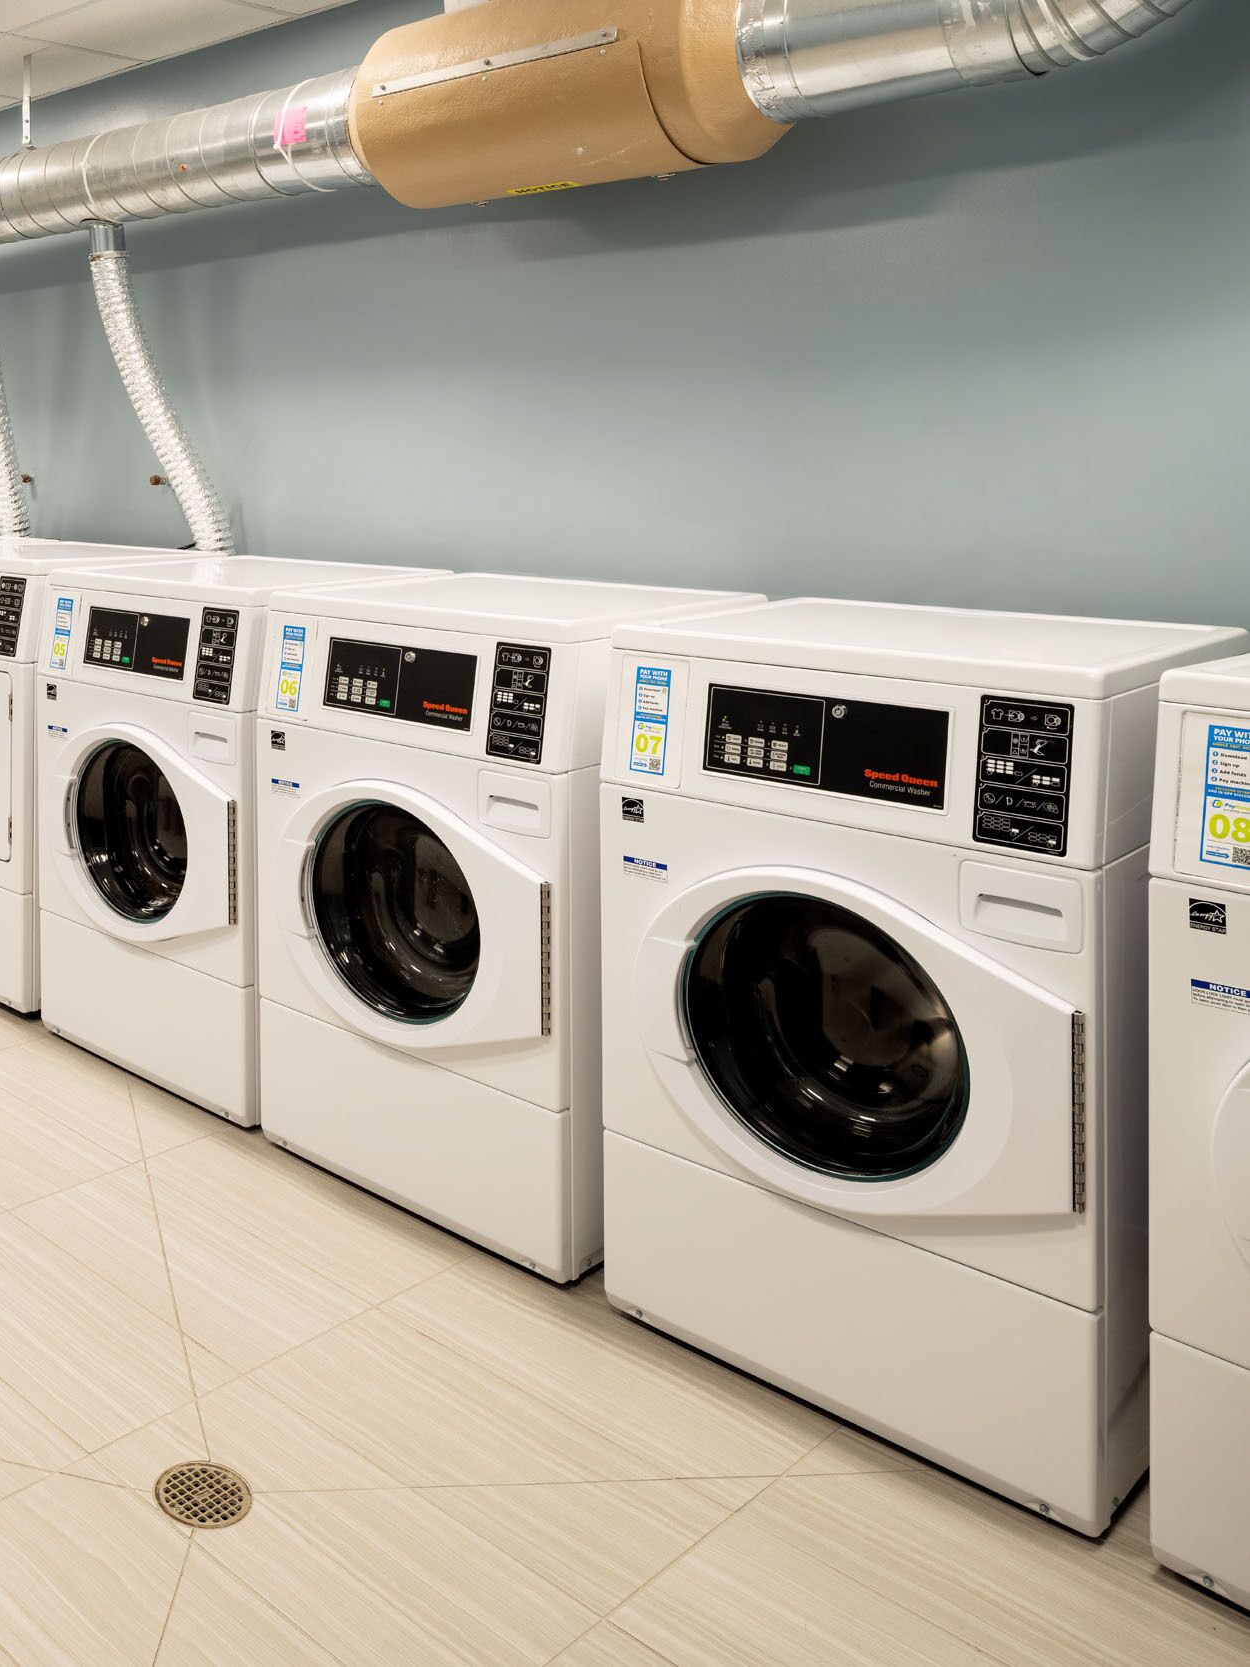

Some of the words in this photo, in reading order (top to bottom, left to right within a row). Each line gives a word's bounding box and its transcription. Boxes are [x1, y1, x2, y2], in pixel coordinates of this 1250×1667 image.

[514, 183, 570, 194] NOTICE
[53, 642, 66, 657] 05
[280, 679, 298, 696] 06
[422, 700, 445, 710] Speed
[445, 704, 468, 715] Queen
[1213, 728, 1232, 737] PAY
[635, 733, 663, 755] 07
[1220, 752, 1248, 760] Download
[863, 768, 900, 781] Speed
[901, 773, 939, 788] Queen
[869, 780, 906, 793] Commercial
[907, 786, 932, 797] Washer
[633, 857, 657, 868] NOTICE
[1209, 983, 1247, 997] NOTICE
